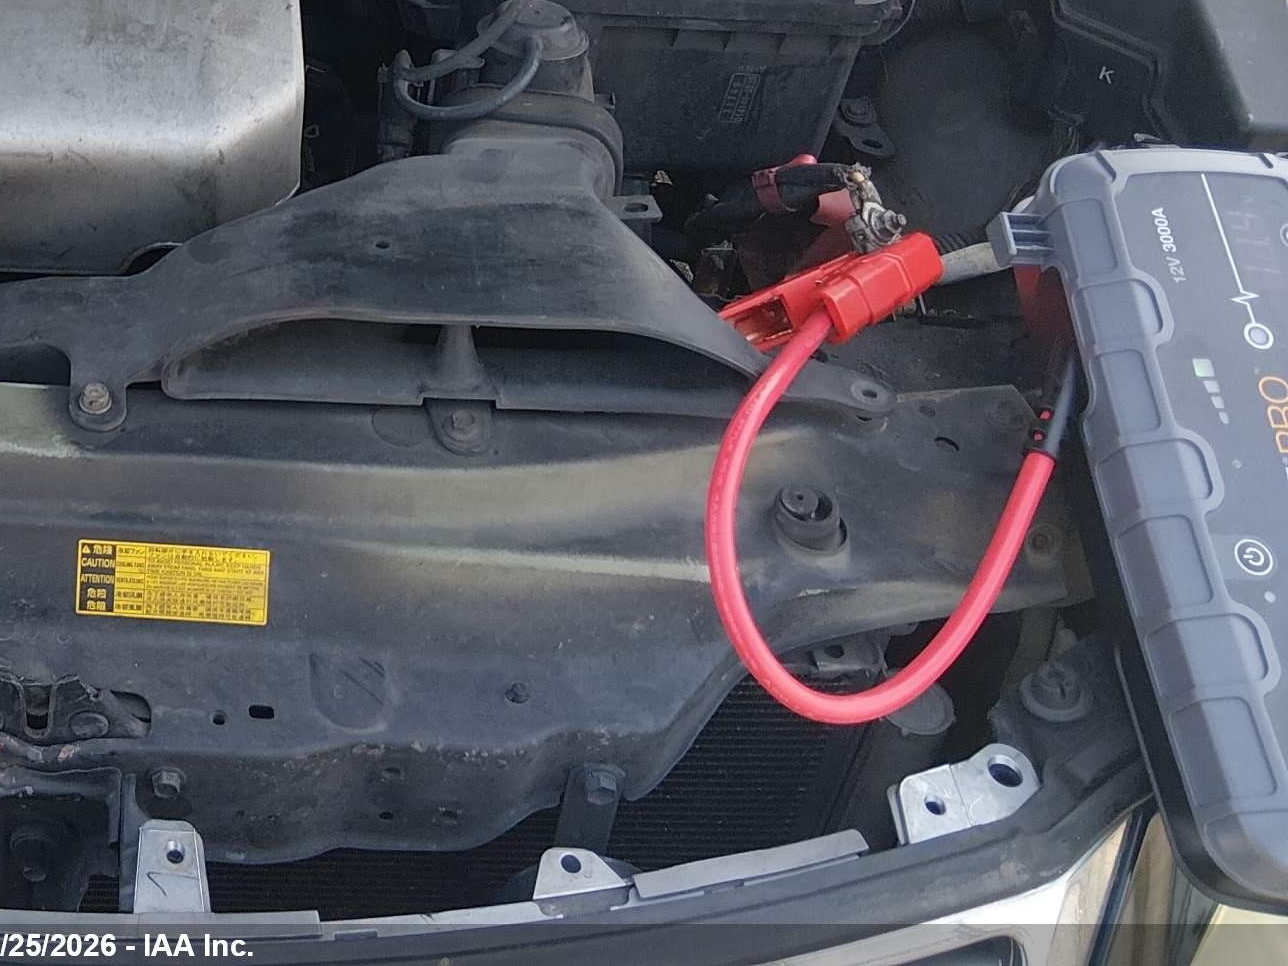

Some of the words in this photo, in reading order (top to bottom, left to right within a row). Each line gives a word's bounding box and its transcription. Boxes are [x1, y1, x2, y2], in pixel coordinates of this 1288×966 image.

[1099, 66, 1115, 84] K
[1151, 206, 1177, 253] 3000A
[1165, 256, 1187, 283] 12V
[81, 557, 115, 569] CAUTION
[81, 573, 115, 585] ATTENTION
